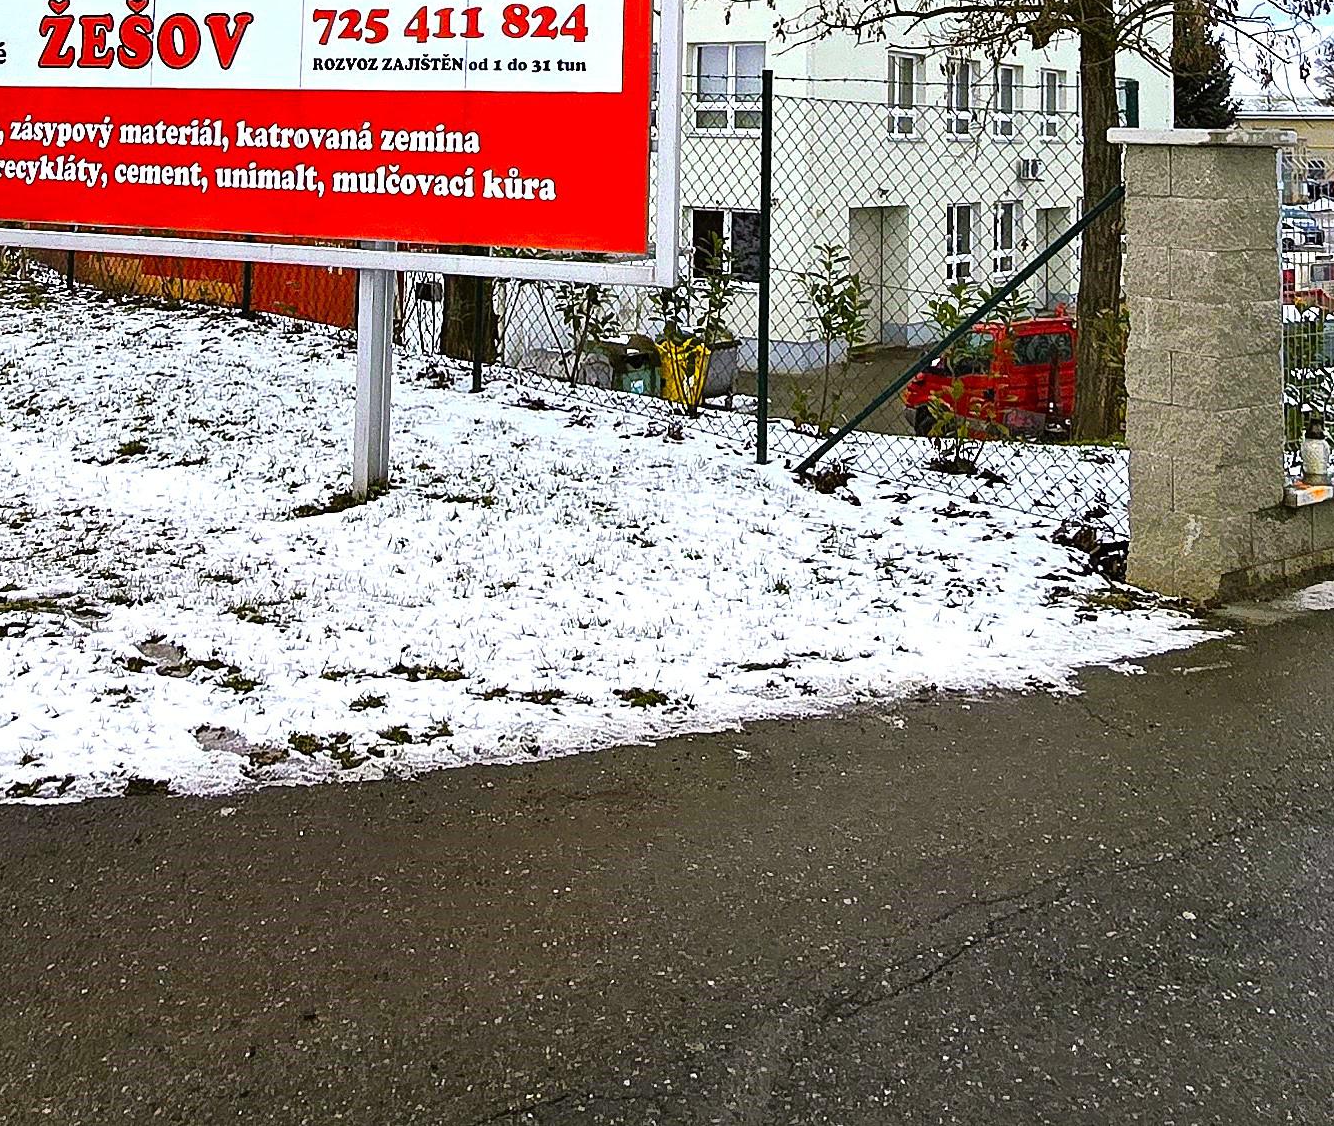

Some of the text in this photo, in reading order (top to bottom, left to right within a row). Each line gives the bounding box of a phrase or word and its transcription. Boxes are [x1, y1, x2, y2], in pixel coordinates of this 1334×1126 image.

[312, 3, 589, 45] 725 411 824
[312, 55, 586, 73] ROZVOZ ZAJIŠTĚN od 1 do 31 tun
[9, 119, 113, 148] zásypový
[119, 118, 229, 152] materiál,
[235, 120, 373, 152] katrovaná
[380, 123, 480, 154] zemina
[113, 164, 208, 193] cement,
[215, 162, 325, 198] unimalt,
[332, 164, 473, 198] mulčovací
[482, 167, 557, 202] kůra
